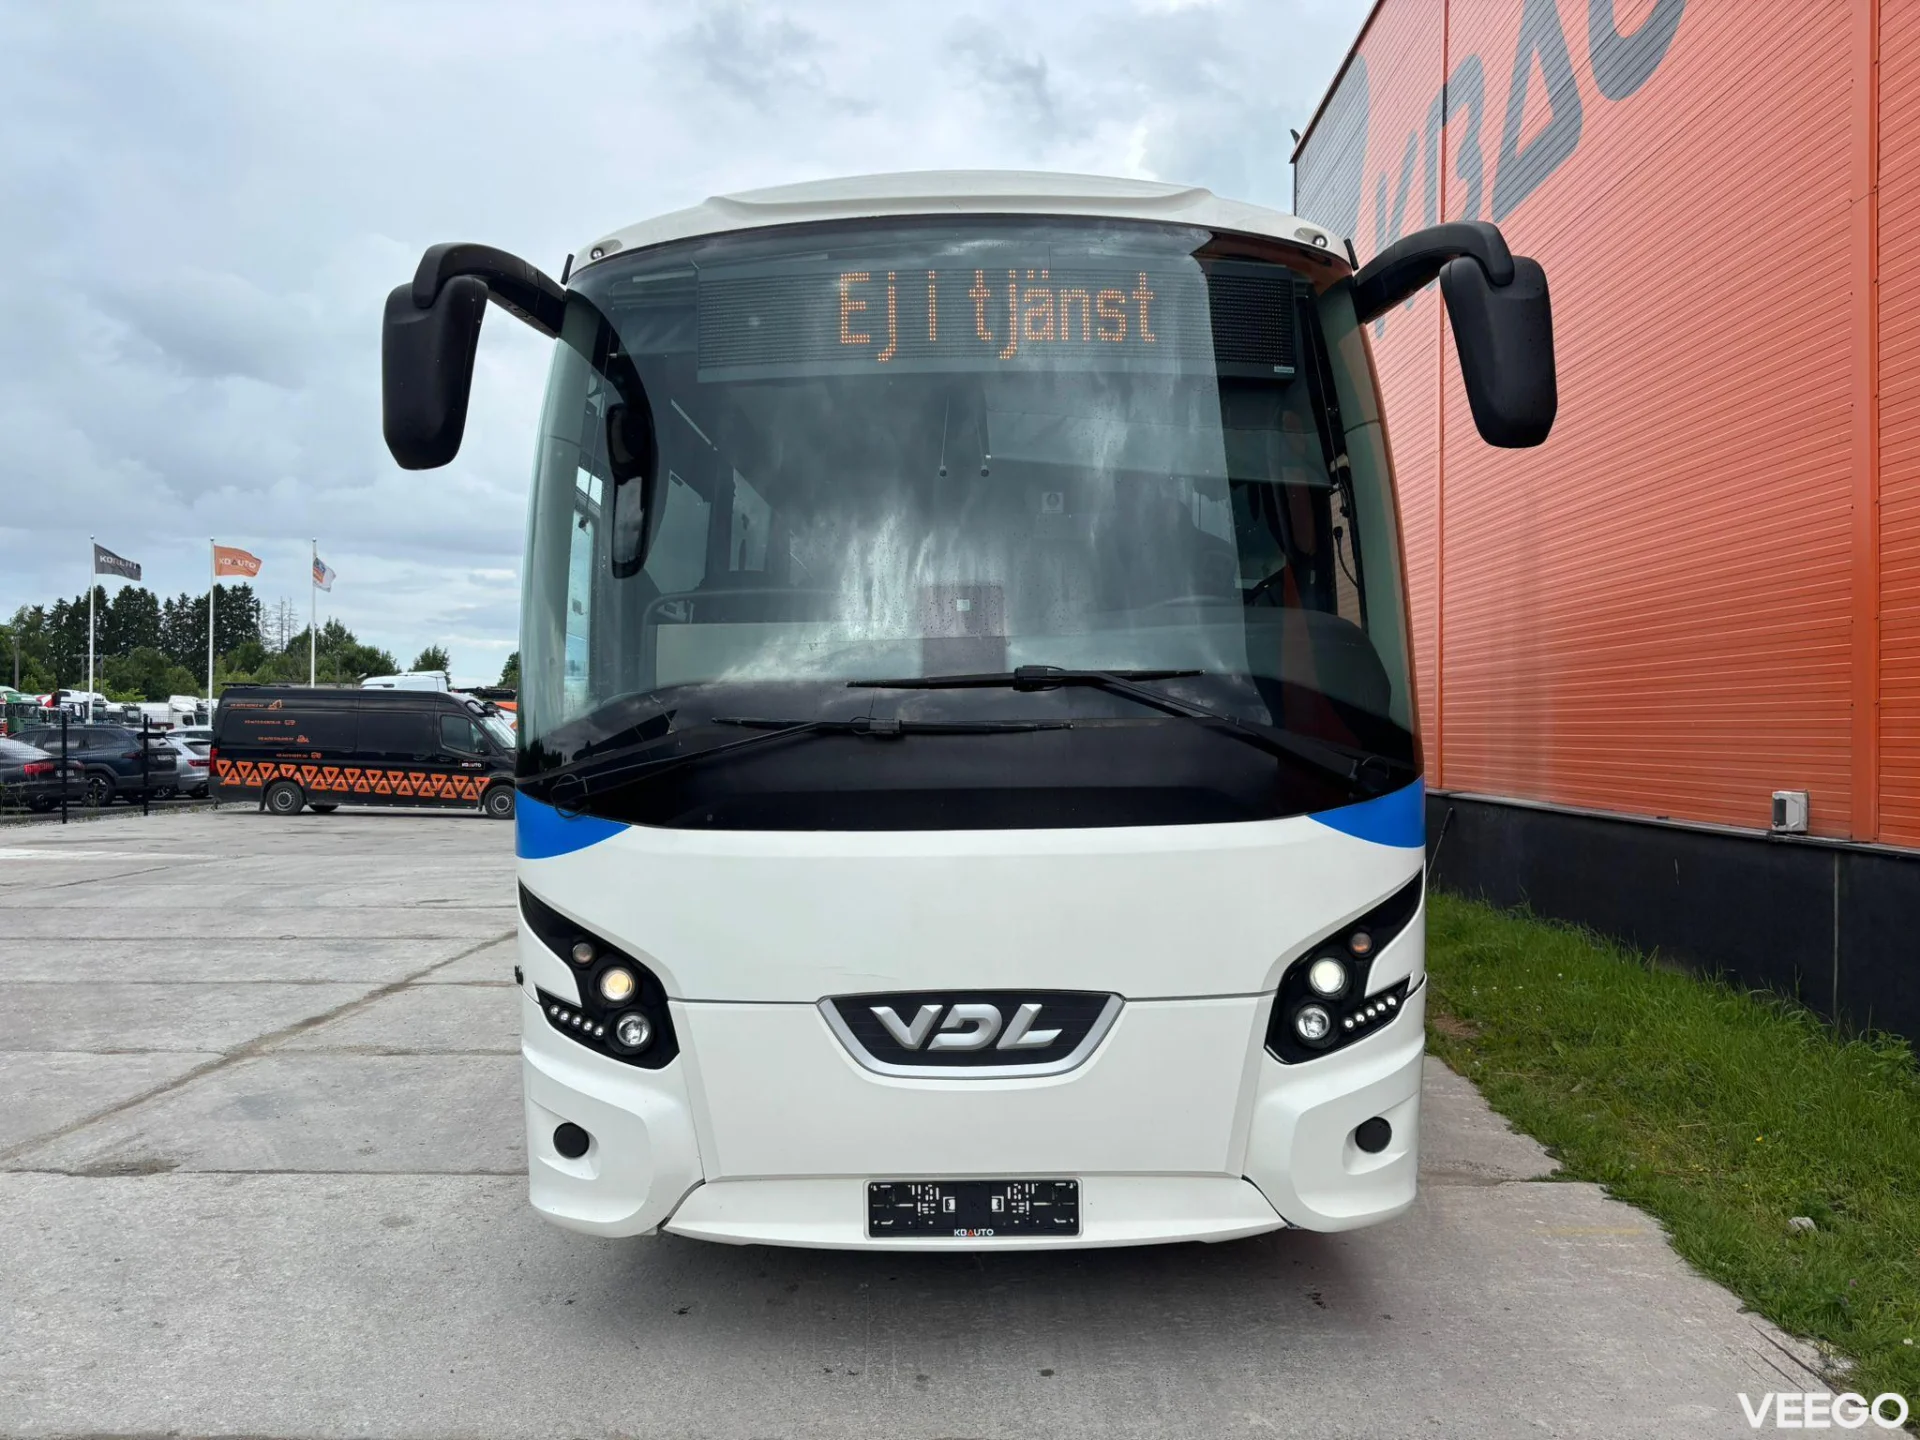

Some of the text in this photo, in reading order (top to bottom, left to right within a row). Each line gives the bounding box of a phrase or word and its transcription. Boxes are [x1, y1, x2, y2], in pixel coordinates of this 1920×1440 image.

[840, 271, 897, 361] Ej
[968, 269, 1156, 360] tjänst
[869, 1003, 1063, 1050] VDL
